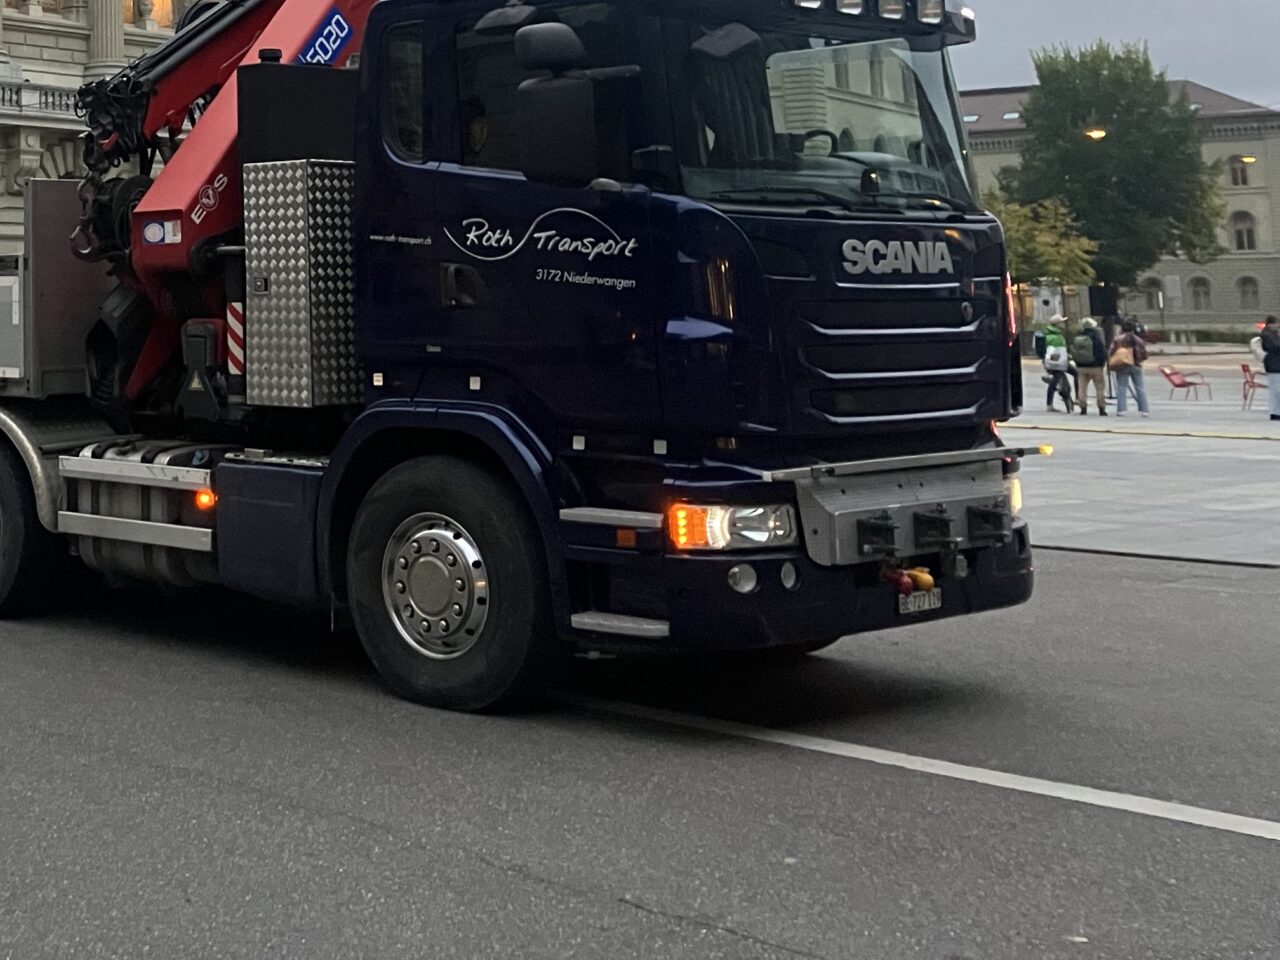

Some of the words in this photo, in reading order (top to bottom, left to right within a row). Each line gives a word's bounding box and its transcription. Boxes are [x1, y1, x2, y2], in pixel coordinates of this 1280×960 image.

[462, 218, 514, 246] Roth
[533, 231, 638, 261] Transport
[842, 239, 954, 275] SCANIA
[535, 269, 562, 282] 3172
[563, 271, 636, 290] Niederwangen
